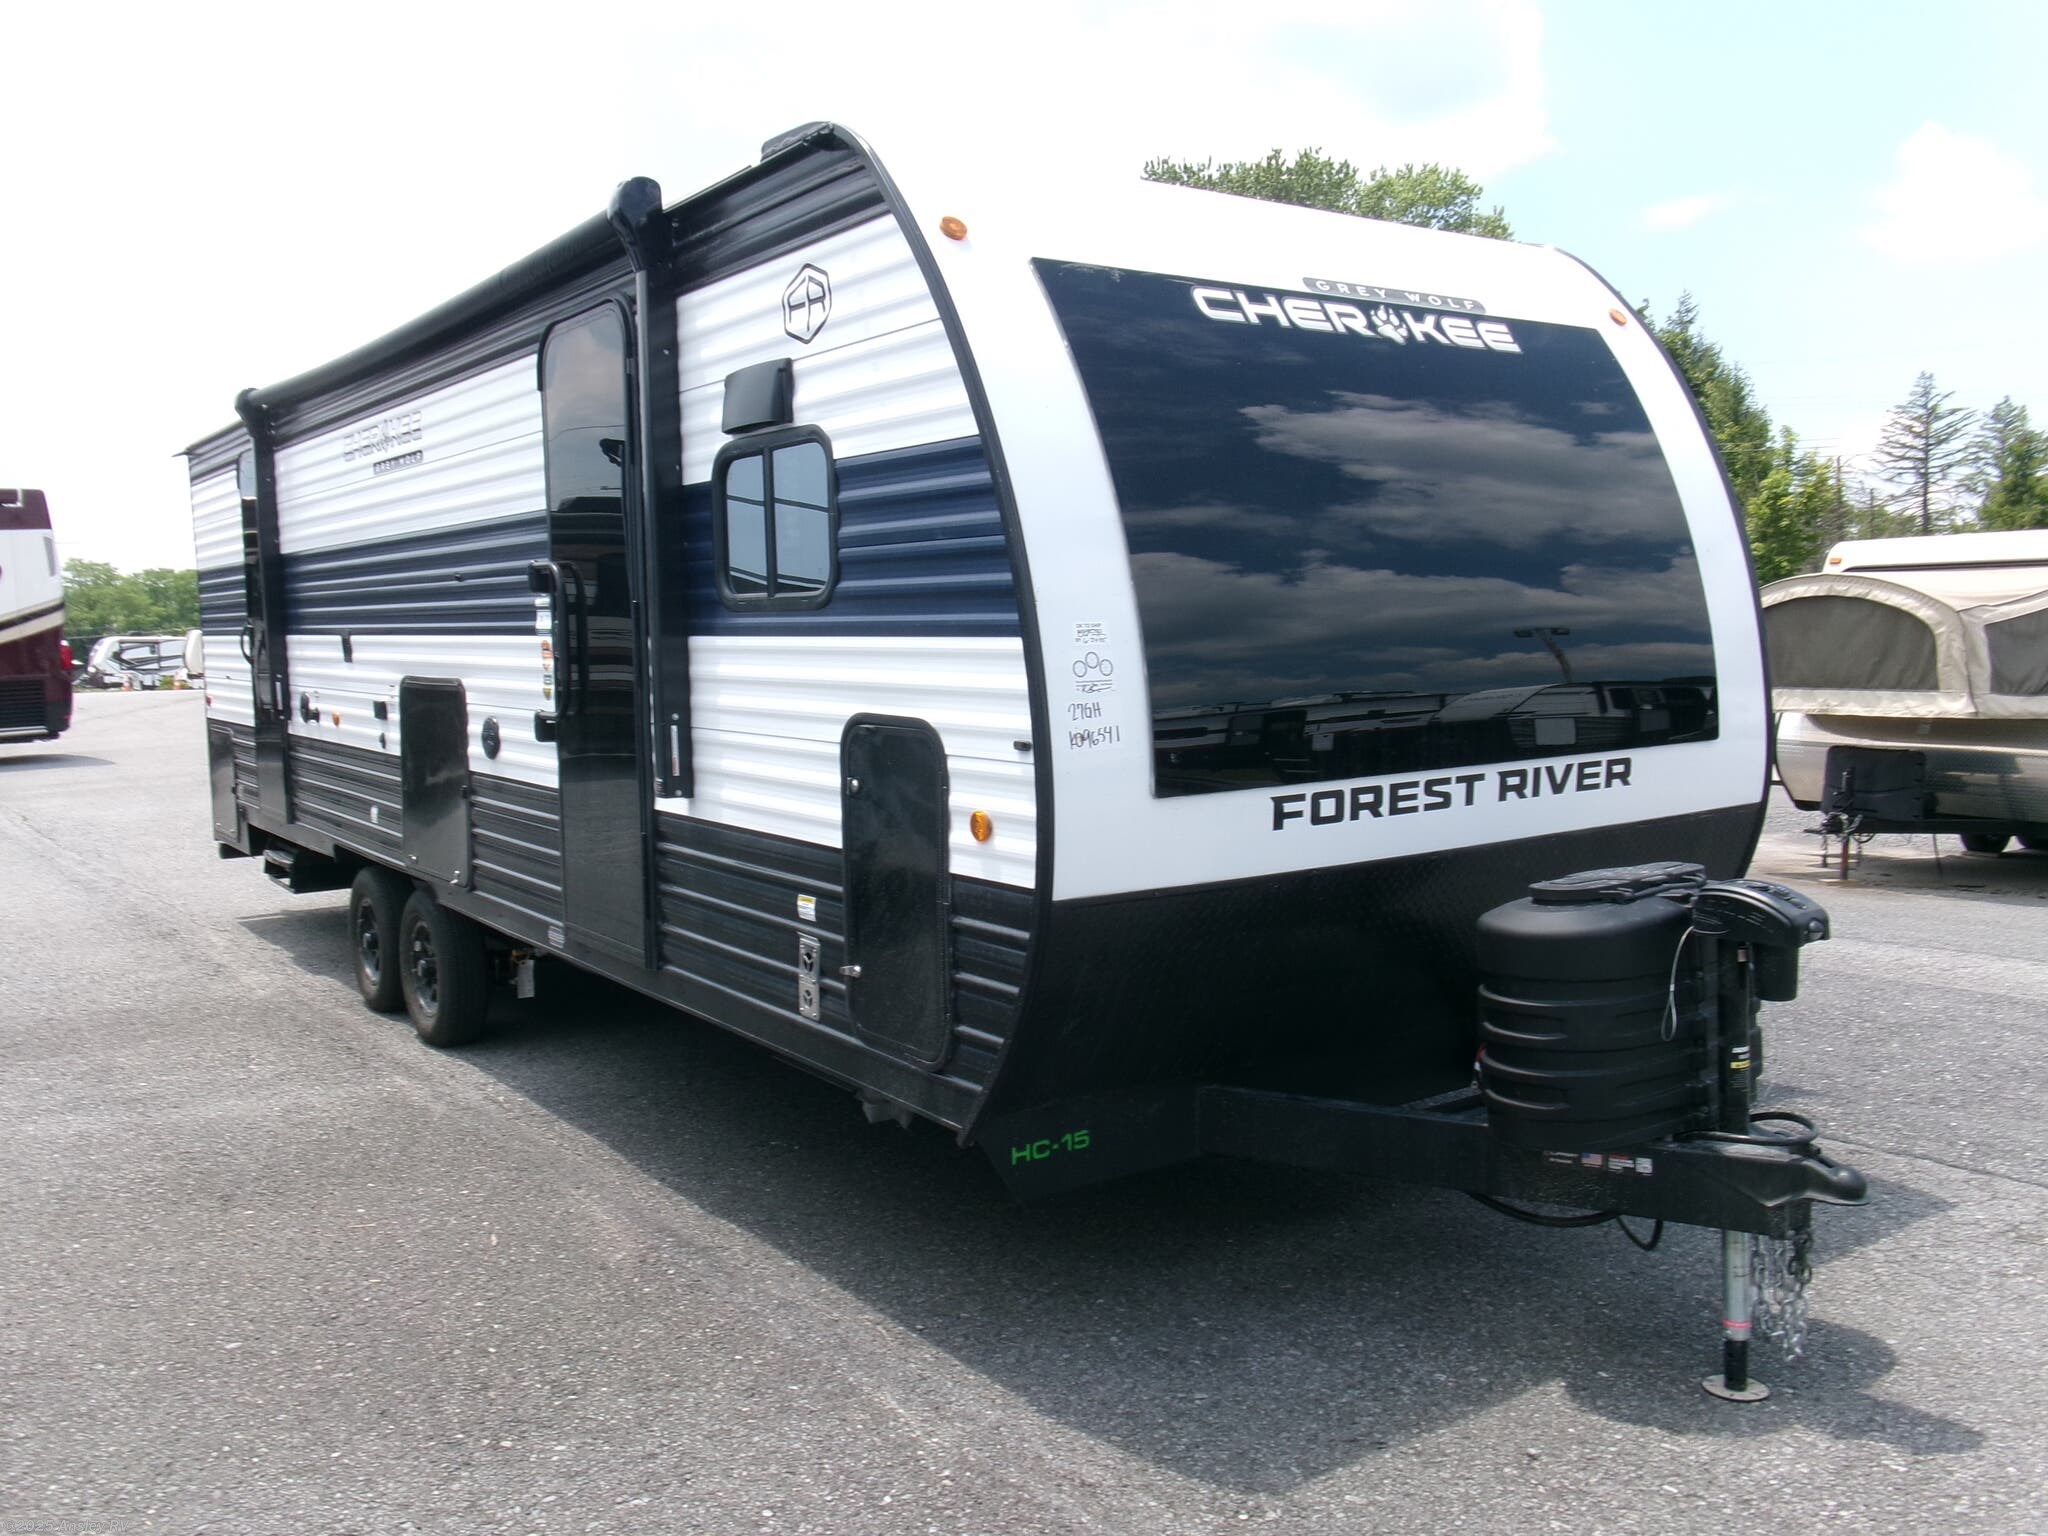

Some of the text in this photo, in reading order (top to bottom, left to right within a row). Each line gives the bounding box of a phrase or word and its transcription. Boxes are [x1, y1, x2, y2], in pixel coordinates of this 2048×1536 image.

[1315, 280, 1474, 311] GREY WOLF
[1270, 756, 1633, 832] FOREST RIVER
